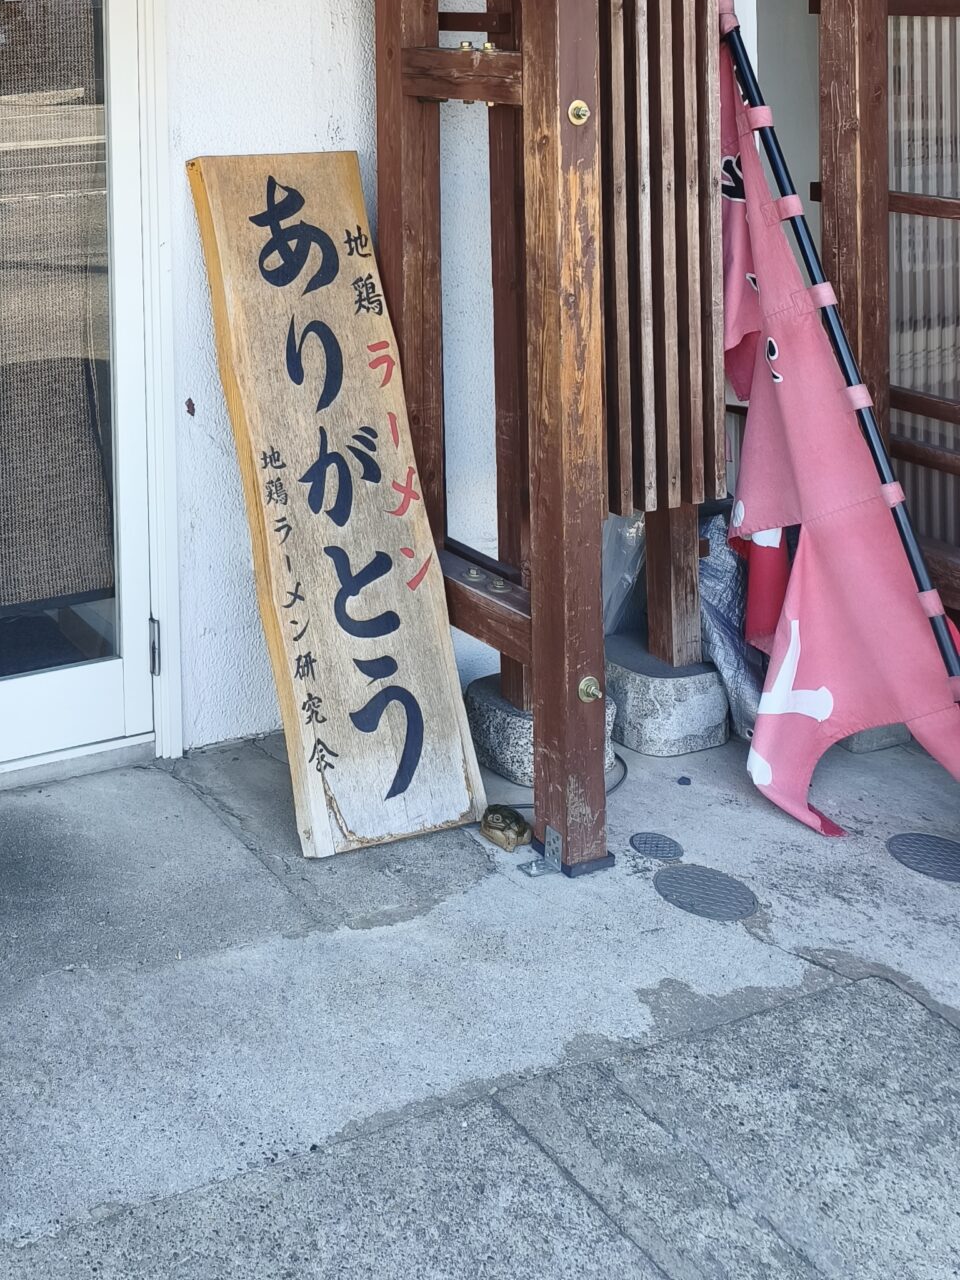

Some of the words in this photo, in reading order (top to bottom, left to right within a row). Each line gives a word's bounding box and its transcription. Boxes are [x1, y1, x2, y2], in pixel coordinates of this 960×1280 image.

[248, 174, 425, 802] ありがとう
[344, 224, 433, 592] 地鶏ラーメン
